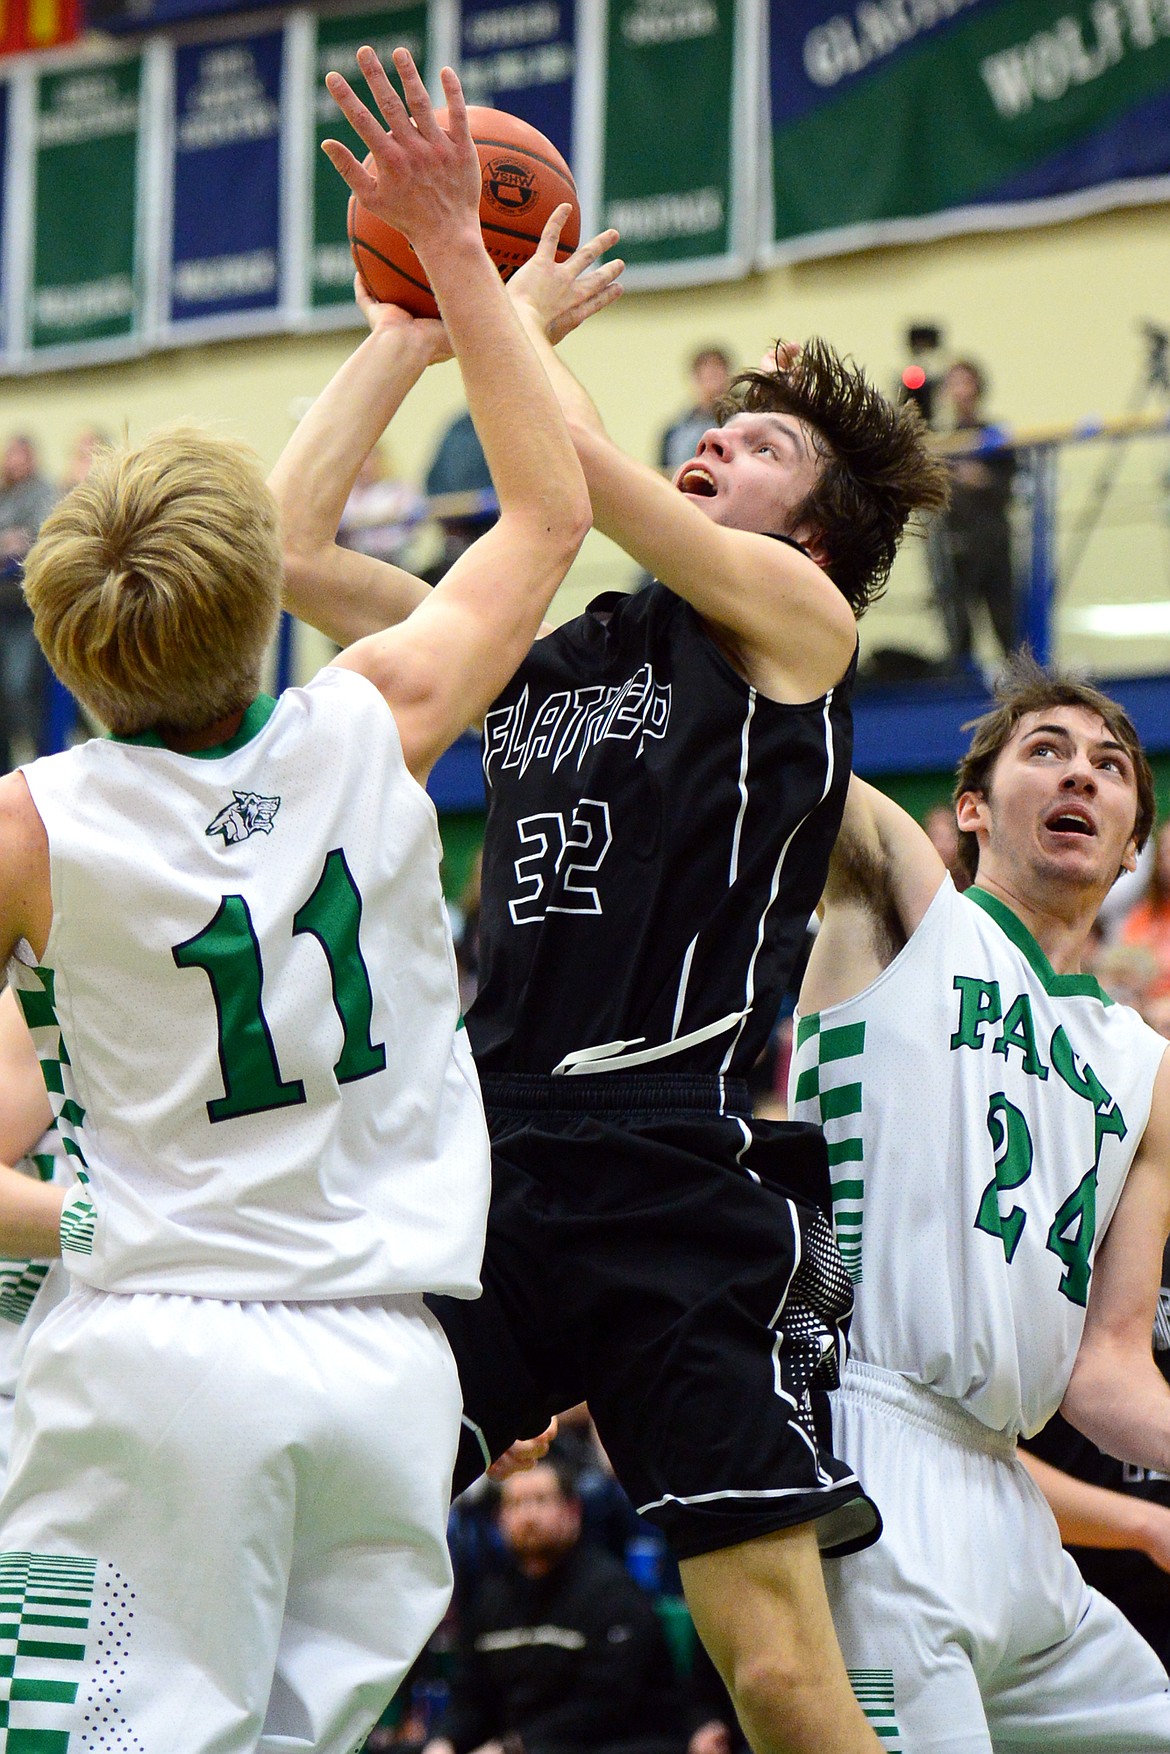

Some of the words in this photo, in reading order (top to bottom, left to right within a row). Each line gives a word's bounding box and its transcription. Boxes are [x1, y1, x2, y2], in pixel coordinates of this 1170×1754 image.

[507, 798, 613, 926] 32
[171, 847, 387, 1124] 11
[974, 1091, 1099, 1308] 24
